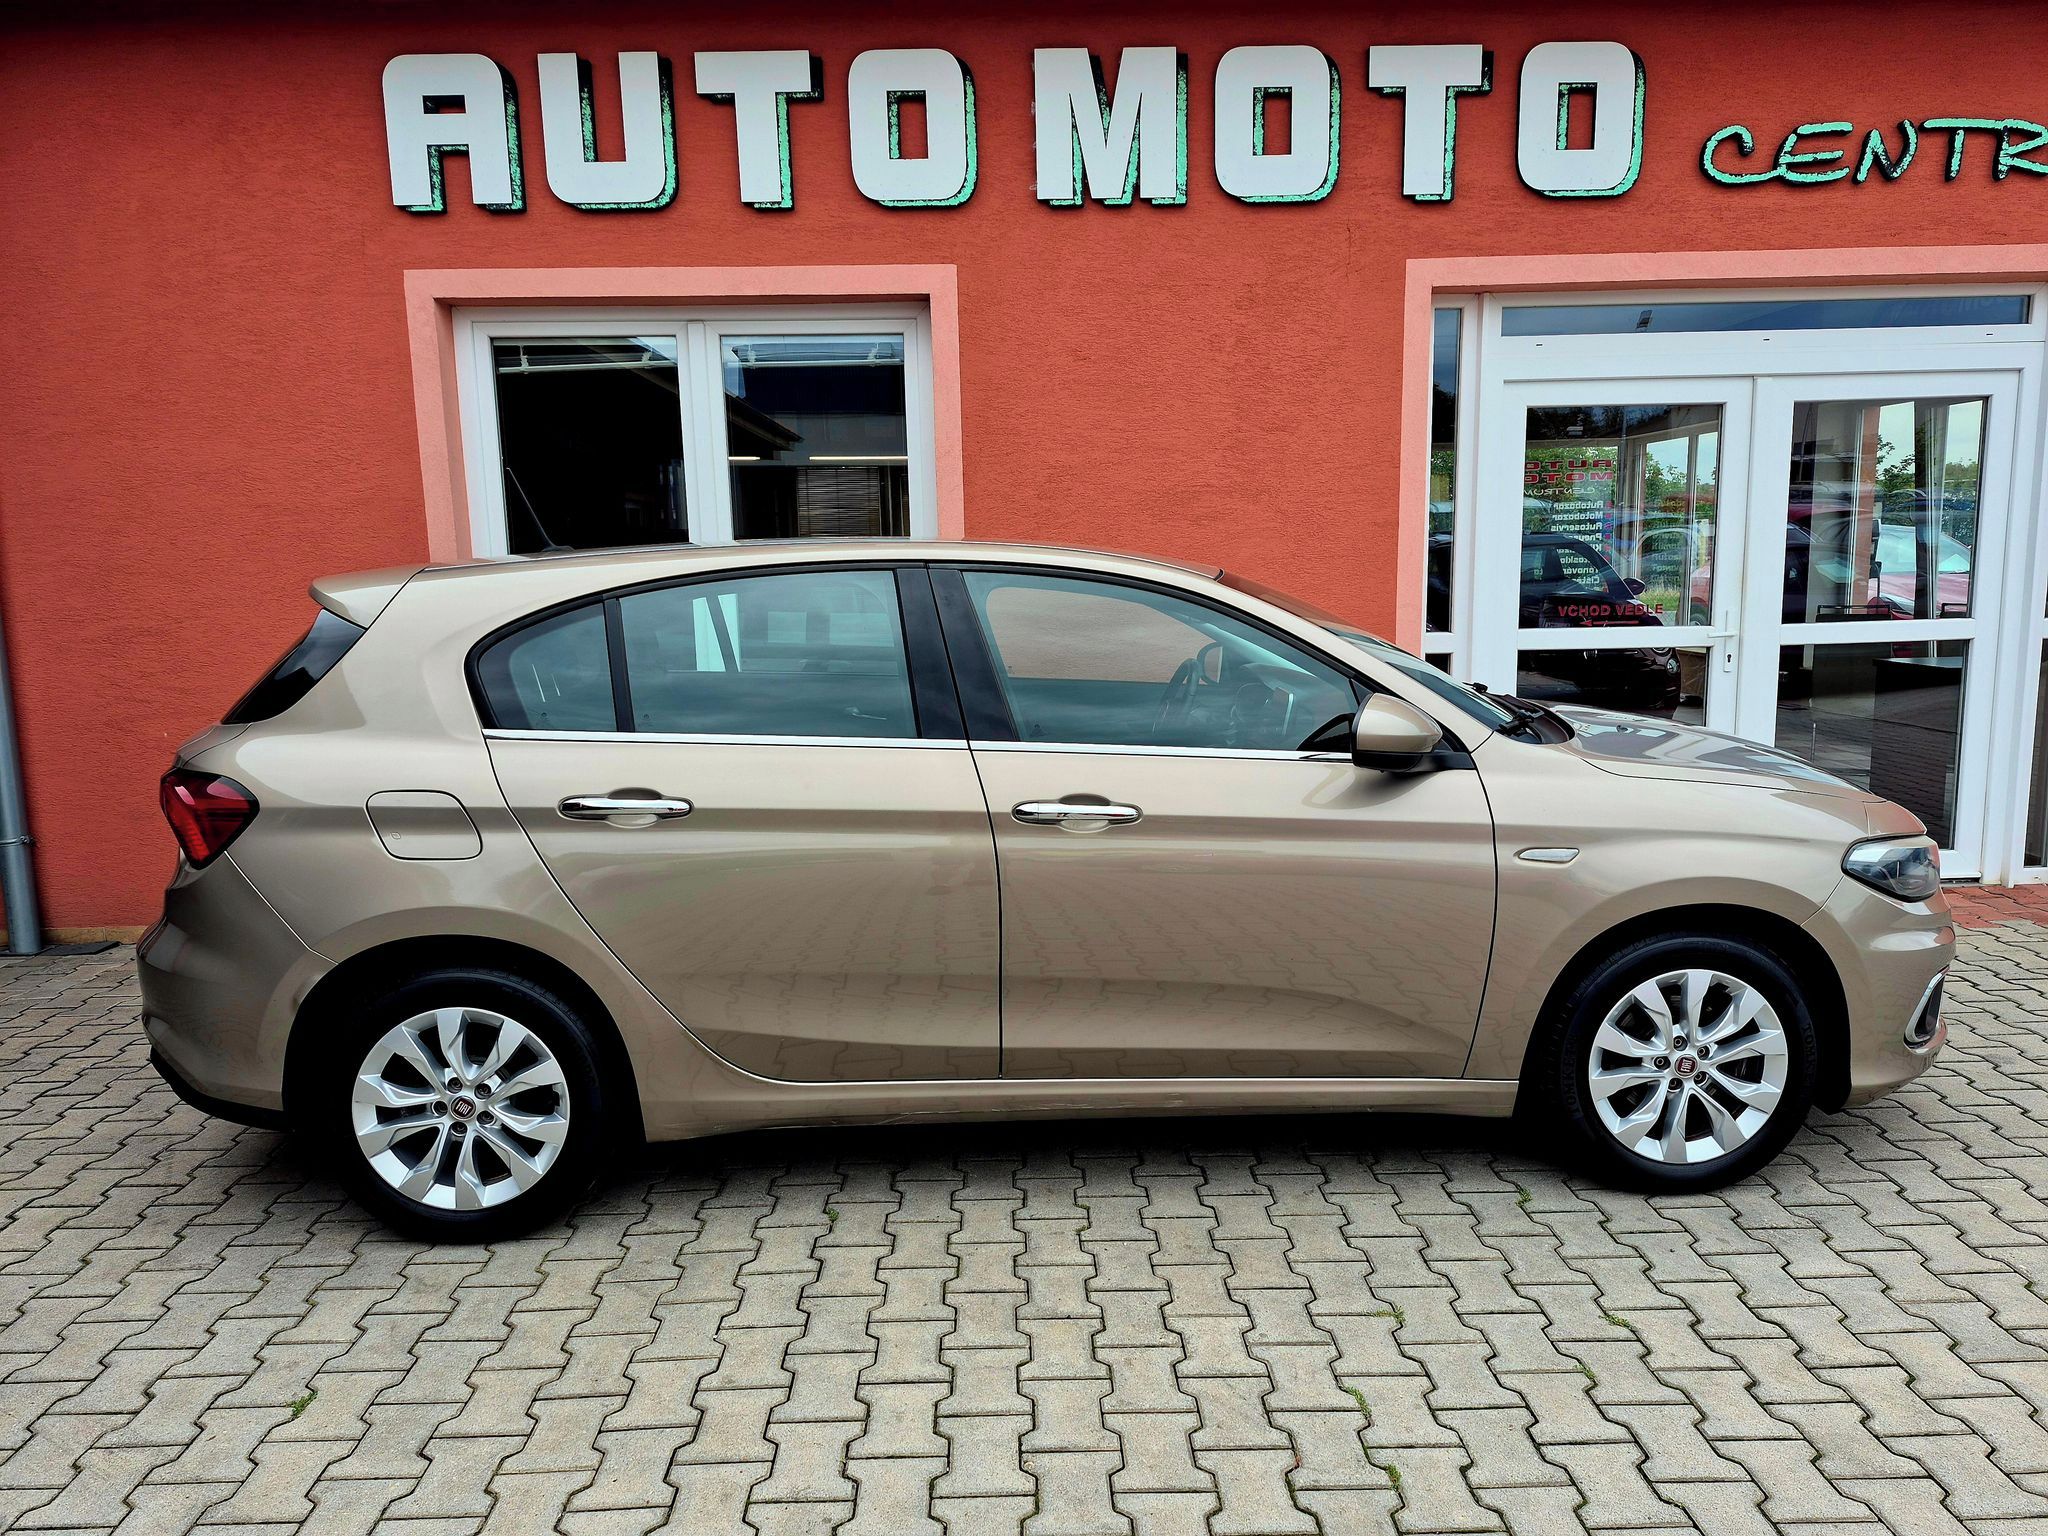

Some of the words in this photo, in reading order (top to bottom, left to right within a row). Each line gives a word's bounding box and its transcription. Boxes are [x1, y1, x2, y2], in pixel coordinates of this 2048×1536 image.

[382, 48, 977, 211] AUTO
[1033, 41, 1646, 207] MOTO
[1701, 117, 2048, 187] CENTR
[1558, 604, 1610, 617] VCHOD
[1615, 603, 1664, 616] VEDLE
[1680, 1058, 1693, 1072] FIAT
[455, 1100, 472, 1115] FIAT
